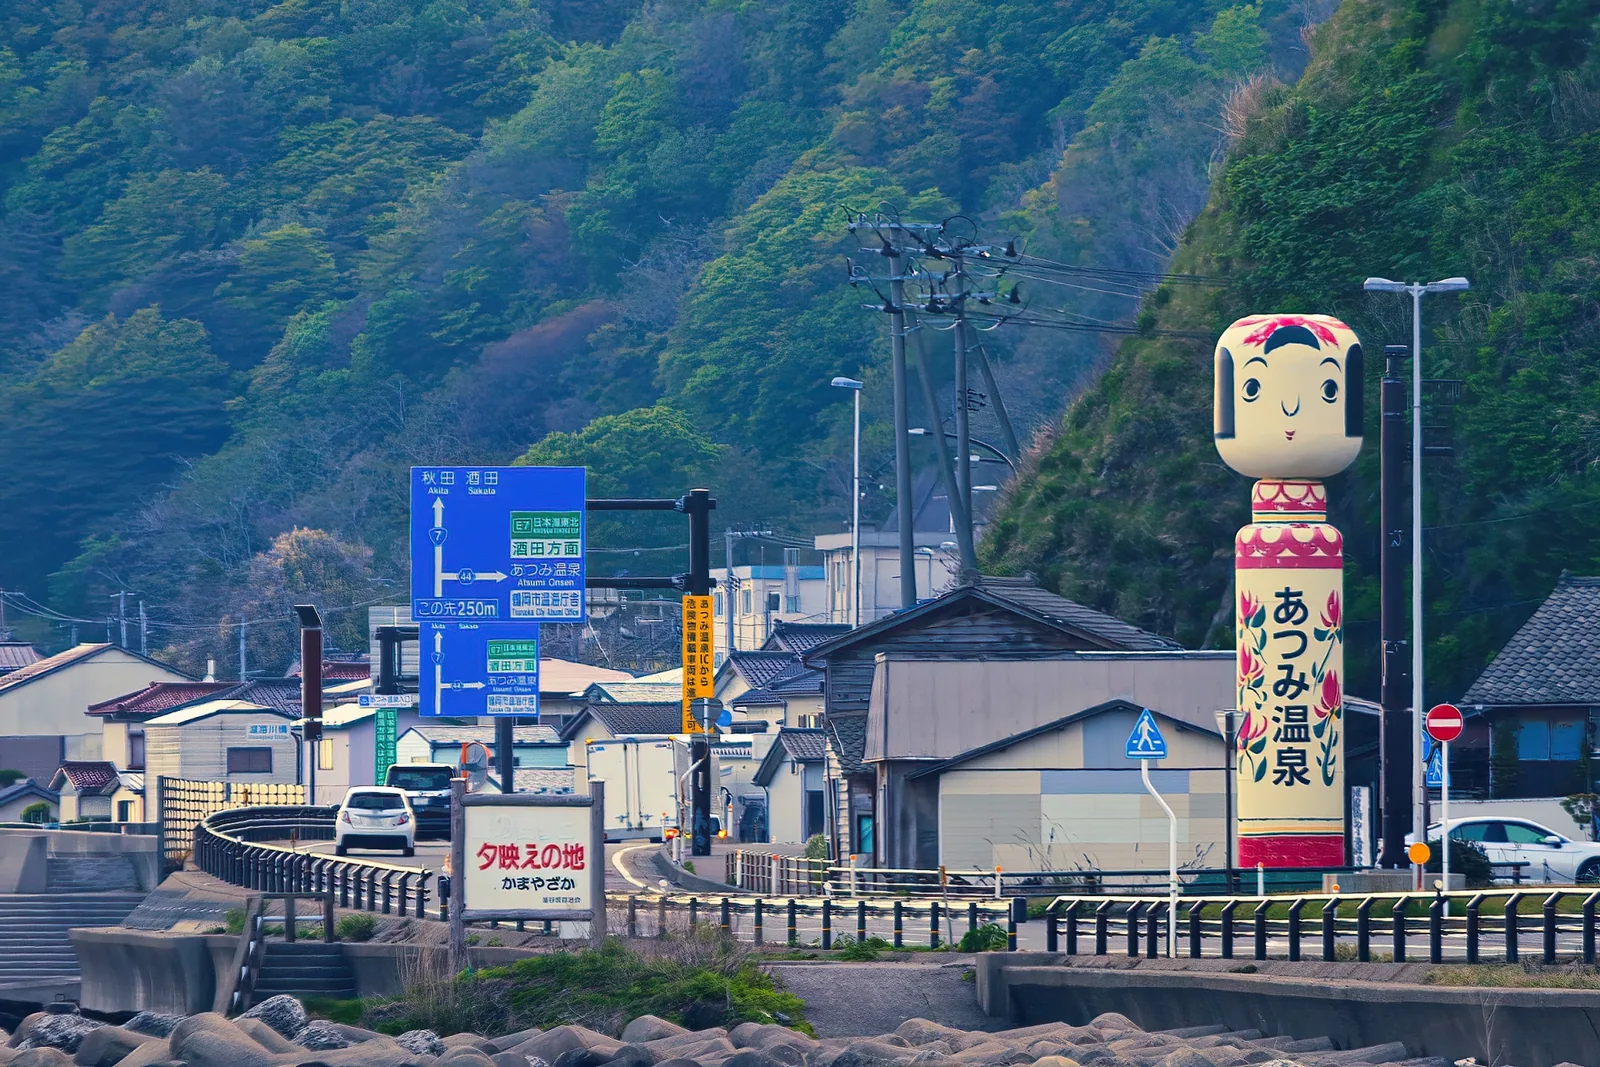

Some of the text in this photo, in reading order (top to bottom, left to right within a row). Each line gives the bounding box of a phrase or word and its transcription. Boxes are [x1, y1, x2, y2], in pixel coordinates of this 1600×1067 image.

[422, 471, 498, 485] 秋田 酒田
[428, 487, 496, 495] Akita Sakata
[515, 520, 530, 531] E7
[434, 530, 442, 541] 7
[513, 541, 579, 556] 酒田方面
[460, 572, 472, 582] 44
[510, 562, 580, 577] あつみ温泉
[518, 579, 574, 587] Atsumi Onsen
[419, 601, 496, 616] この先250m
[699, 599, 710, 687] あつみ温泉ICから
[686, 598, 698, 731] 危険物積載車両は進不可
[1272, 586, 1311, 787] あつみ温泉
[476, 842, 585, 871] 夕映えの地
[501, 876, 576, 891] かまやざか
